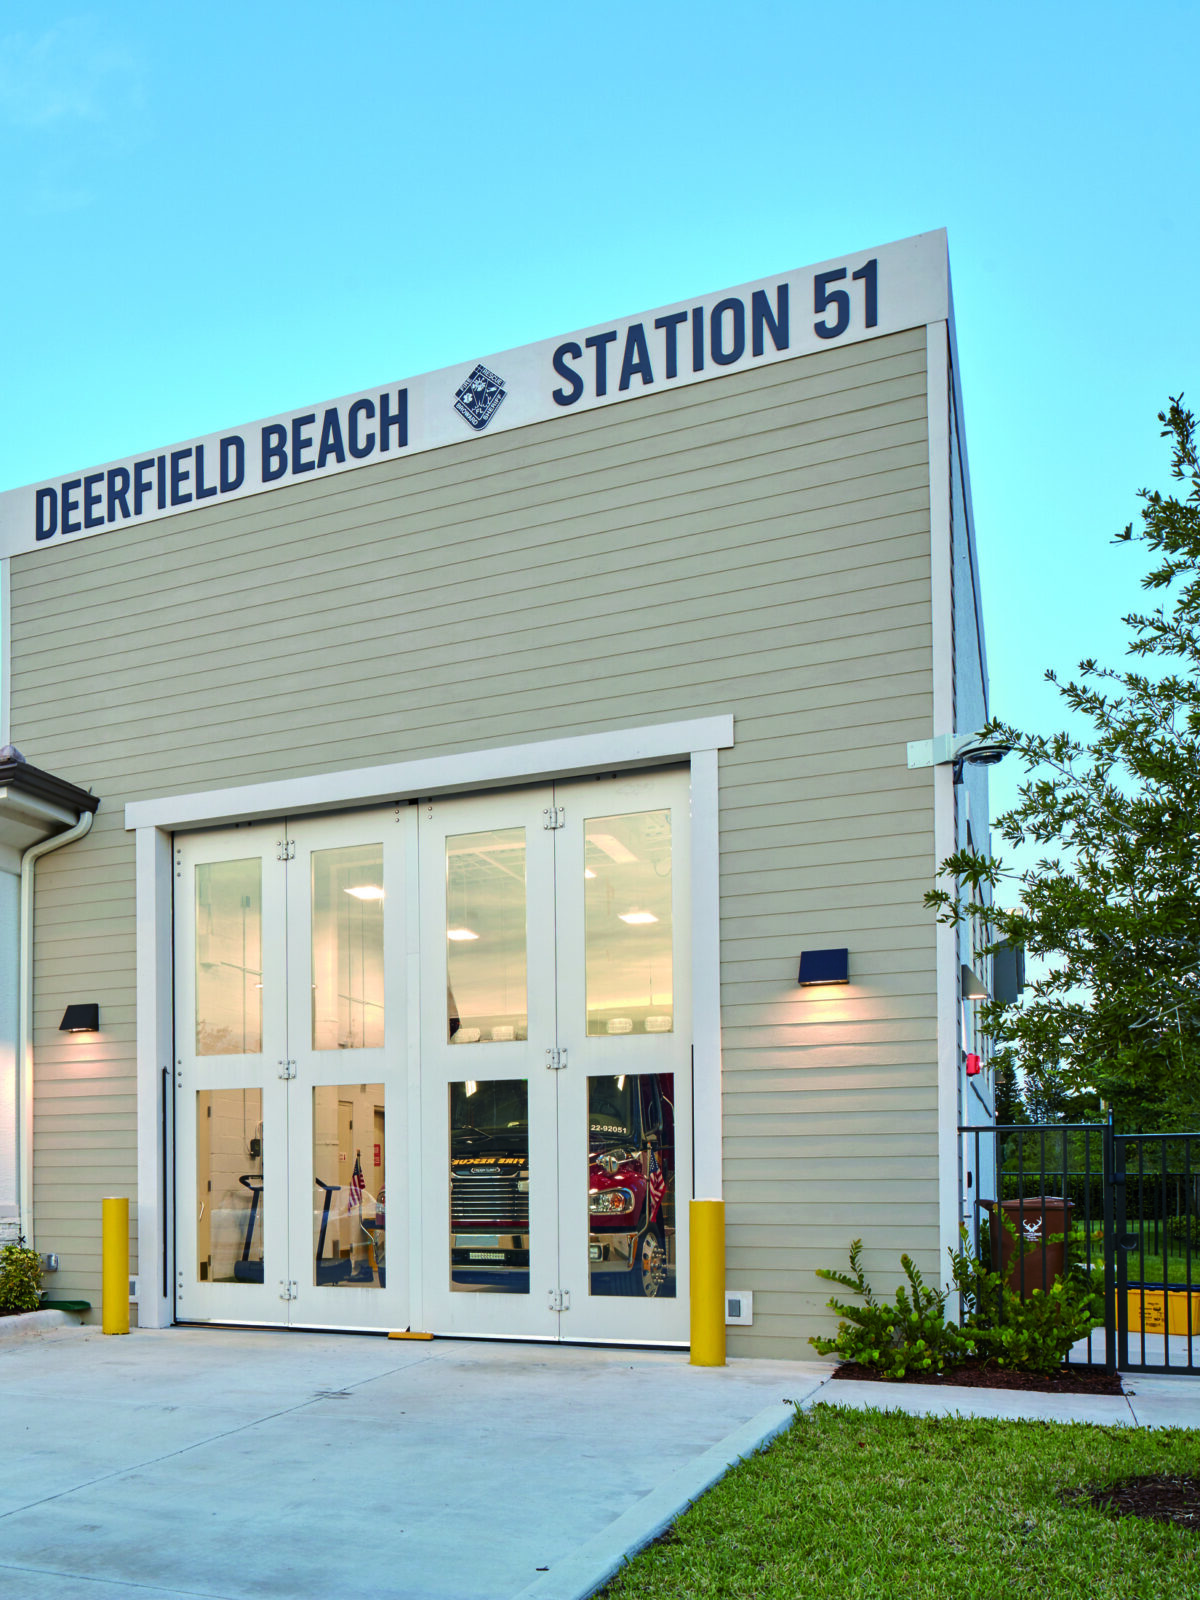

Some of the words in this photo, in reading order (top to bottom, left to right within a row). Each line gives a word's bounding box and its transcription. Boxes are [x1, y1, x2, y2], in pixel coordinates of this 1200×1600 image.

[552, 283, 789, 406] STATION
[813, 258, 877, 339] 51
[482, 369, 503, 386] RESCUE
[455, 402, 479, 426] BROWARD
[482, 393, 502, 421] SHERIFF
[35, 435, 245, 541] DEERFIELD
[261, 388, 408, 483] BEACH
[590, 1124, 627, 1134] 22-92051
